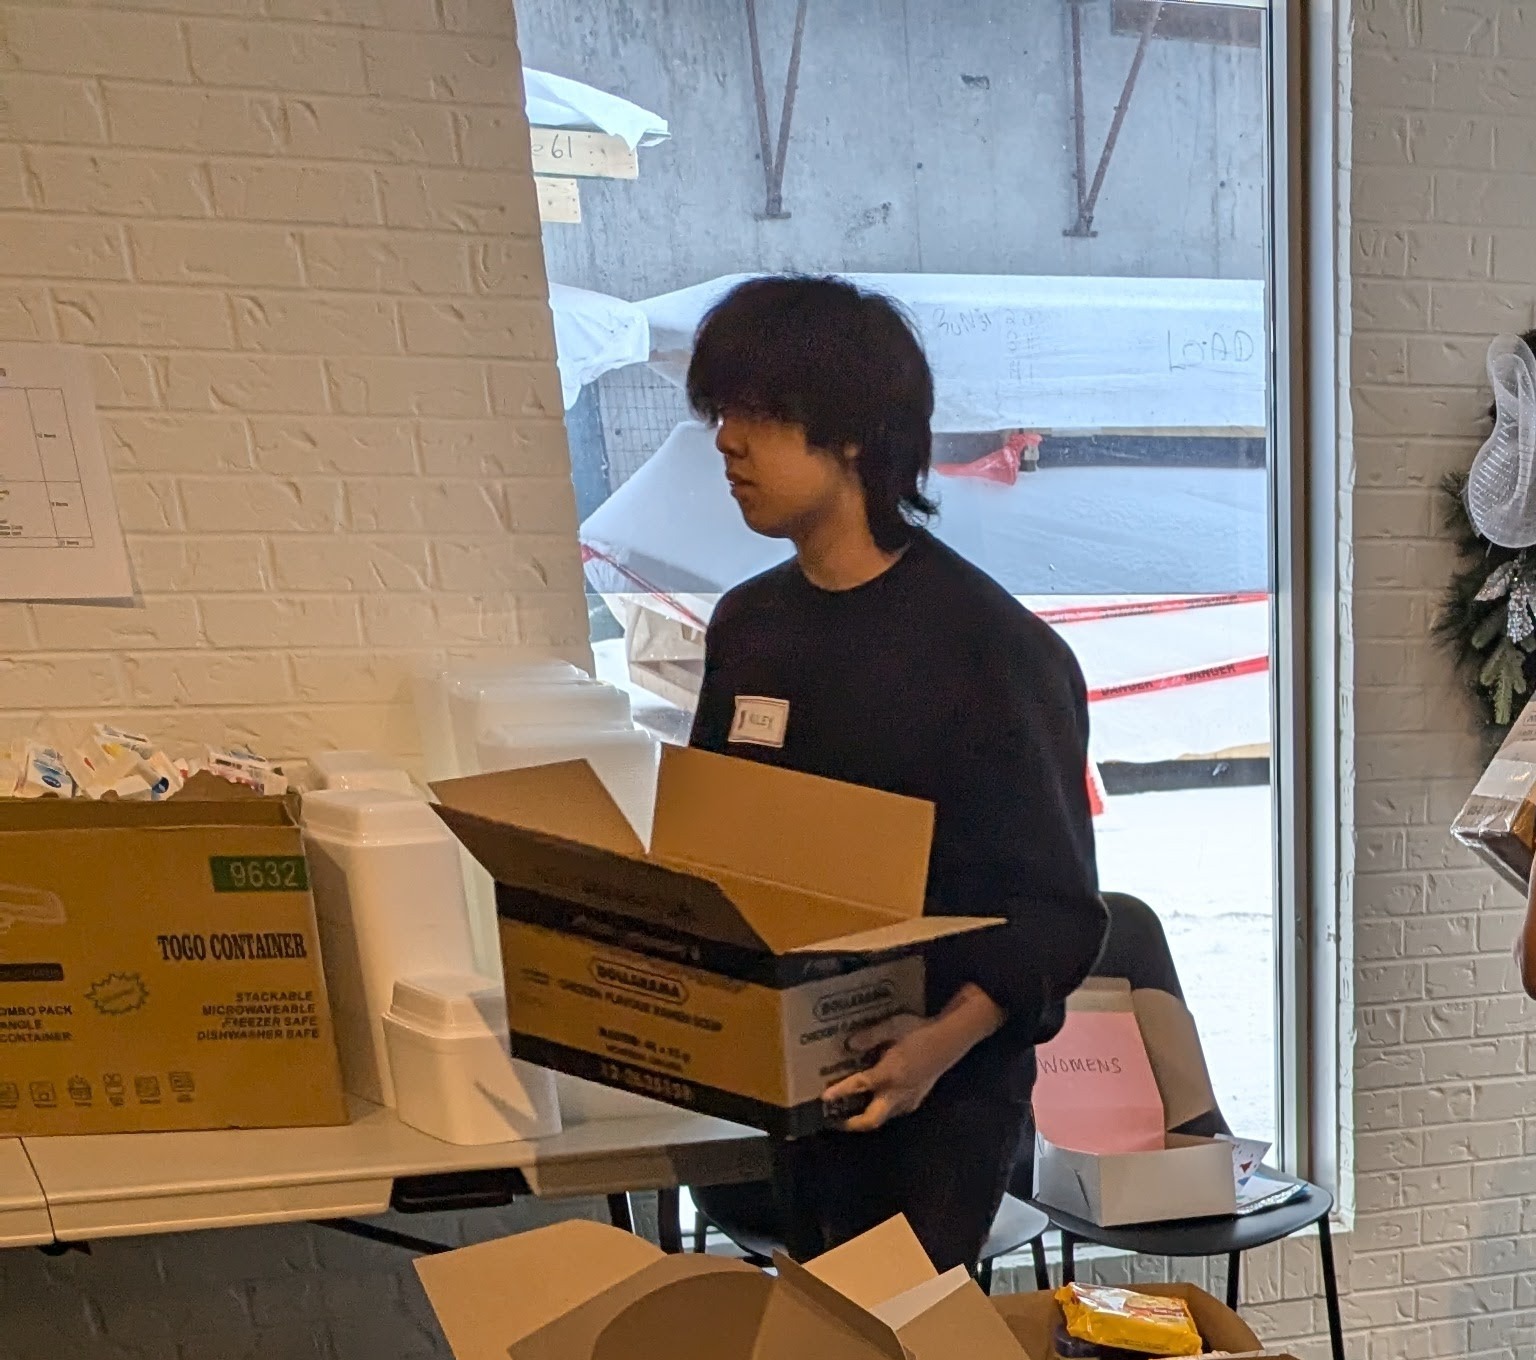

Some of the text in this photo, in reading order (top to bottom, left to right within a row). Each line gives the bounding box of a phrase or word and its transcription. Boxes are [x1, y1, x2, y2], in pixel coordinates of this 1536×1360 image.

[551, 133, 572, 158] 61
[230, 860, 299, 888] 9632
[157, 933, 307, 961] TOGO CONTAINER
[235, 990, 314, 1003] STACKABLE
[39, 1004, 73, 1016] PACK
[202, 1003, 317, 1017] MICROWAVEABLE
[284, 1015, 319, 1027] SAFE
[1038, 1056, 1123, 1075] WOMENS
